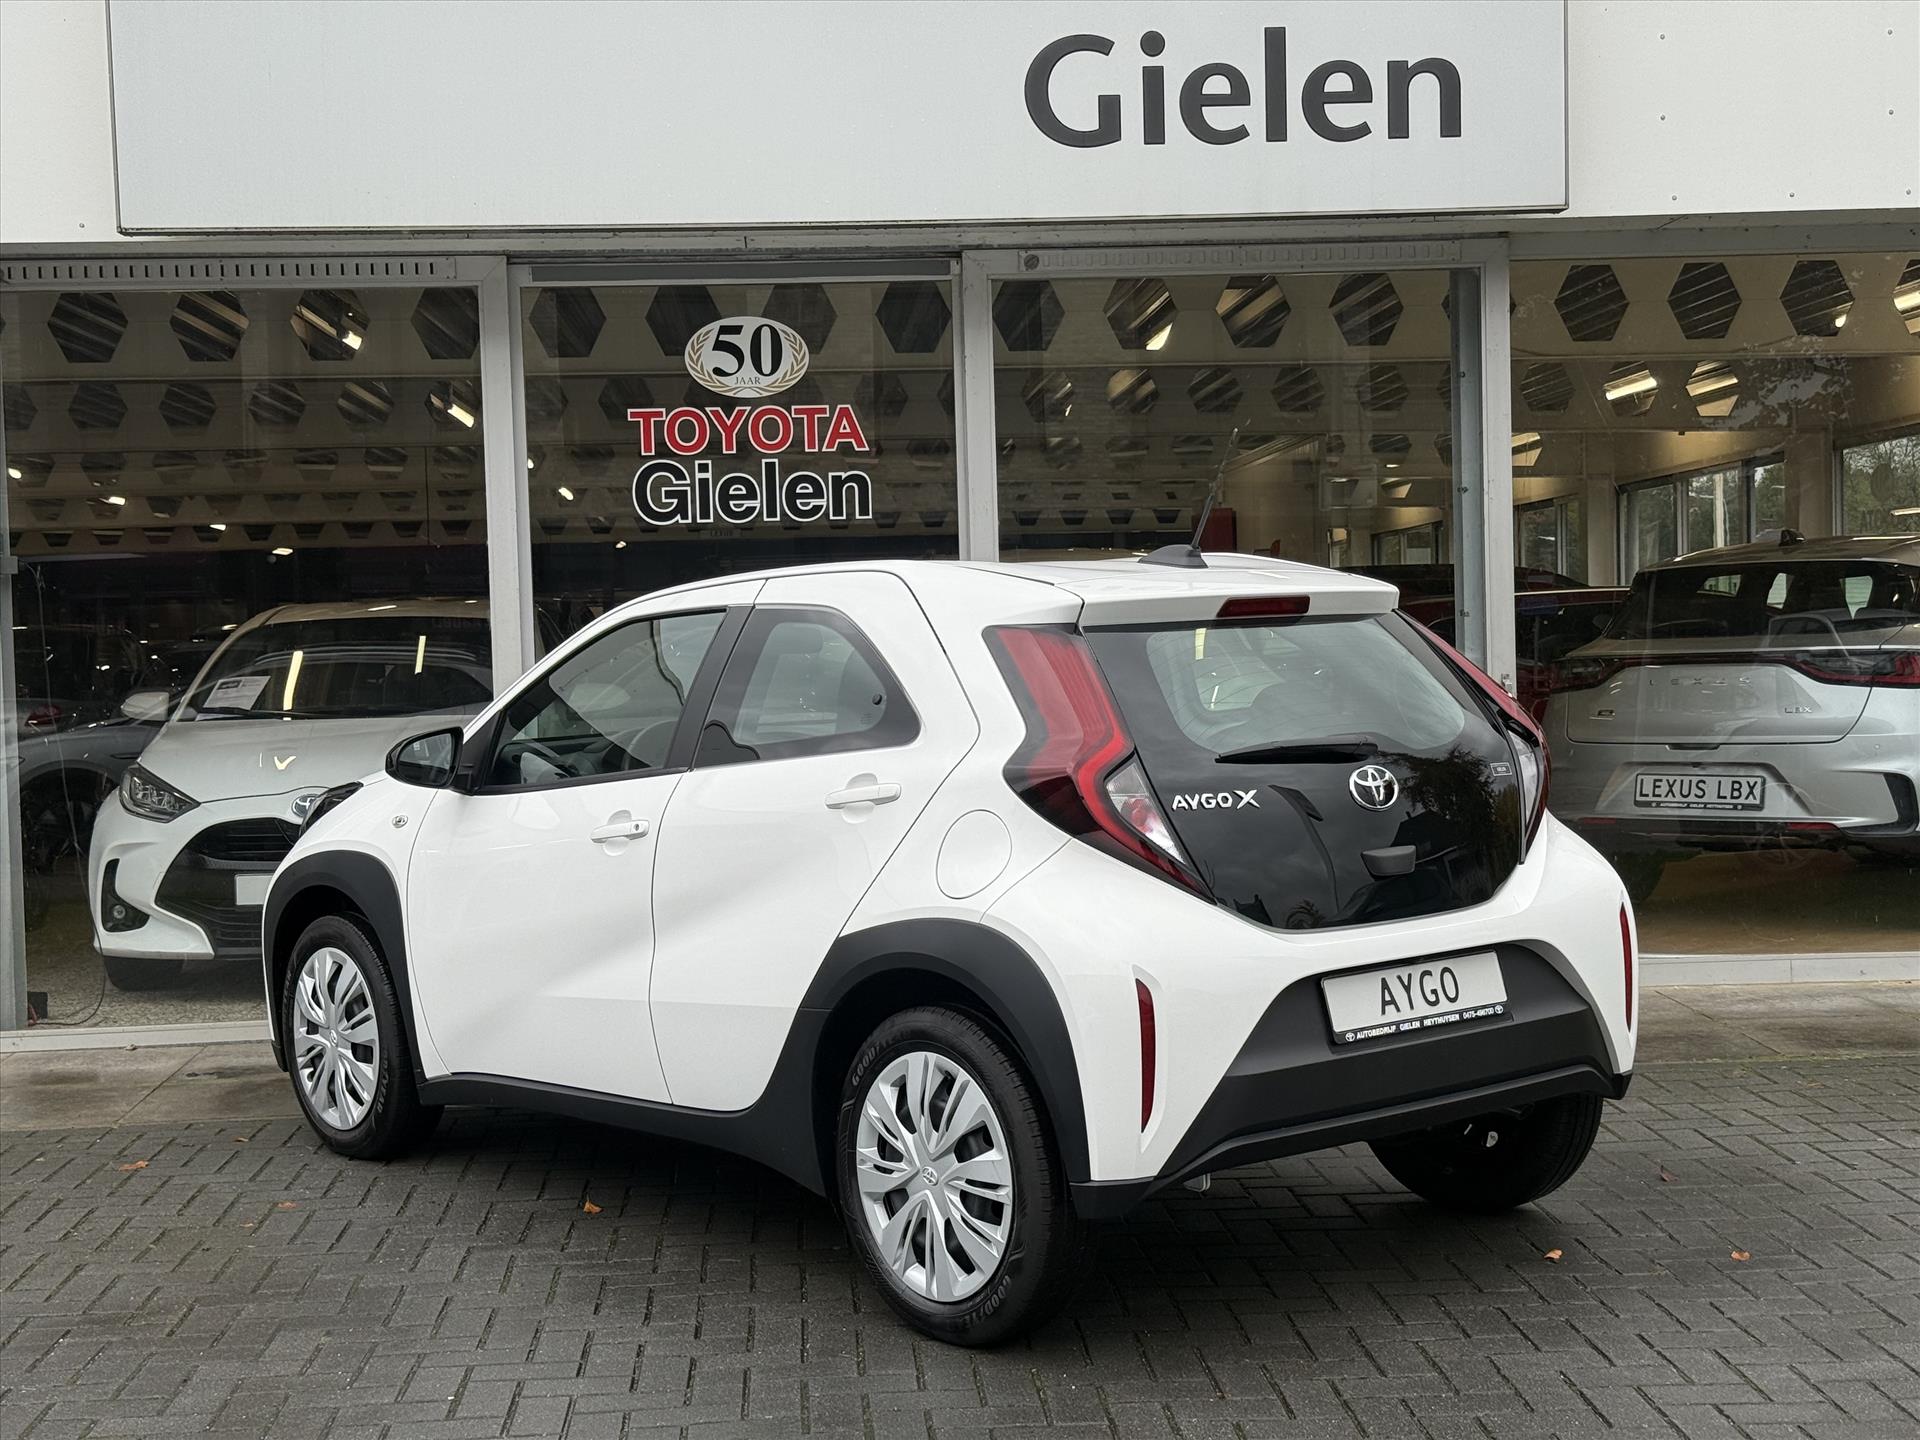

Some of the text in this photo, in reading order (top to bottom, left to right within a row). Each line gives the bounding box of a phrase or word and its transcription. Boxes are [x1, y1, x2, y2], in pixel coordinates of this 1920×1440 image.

[1024, 26, 1462, 148] Gielen
[711, 323, 783, 377] 50
[734, 376, 761, 386] JAAR
[627, 404, 870, 456] TOYOTA
[632, 458, 873, 526] Gielen
[1172, 793, 1232, 811] AYGO
[1639, 778, 1759, 801] LEXUS LBX
[1379, 966, 1460, 1016] AYGO
[1356, 1025, 1397, 1040] AUTOBEDRIJF
[1399, 1020, 1421, 1031] GIELEN
[1423, 1013, 1460, 1027] HEYTHUYSEN
